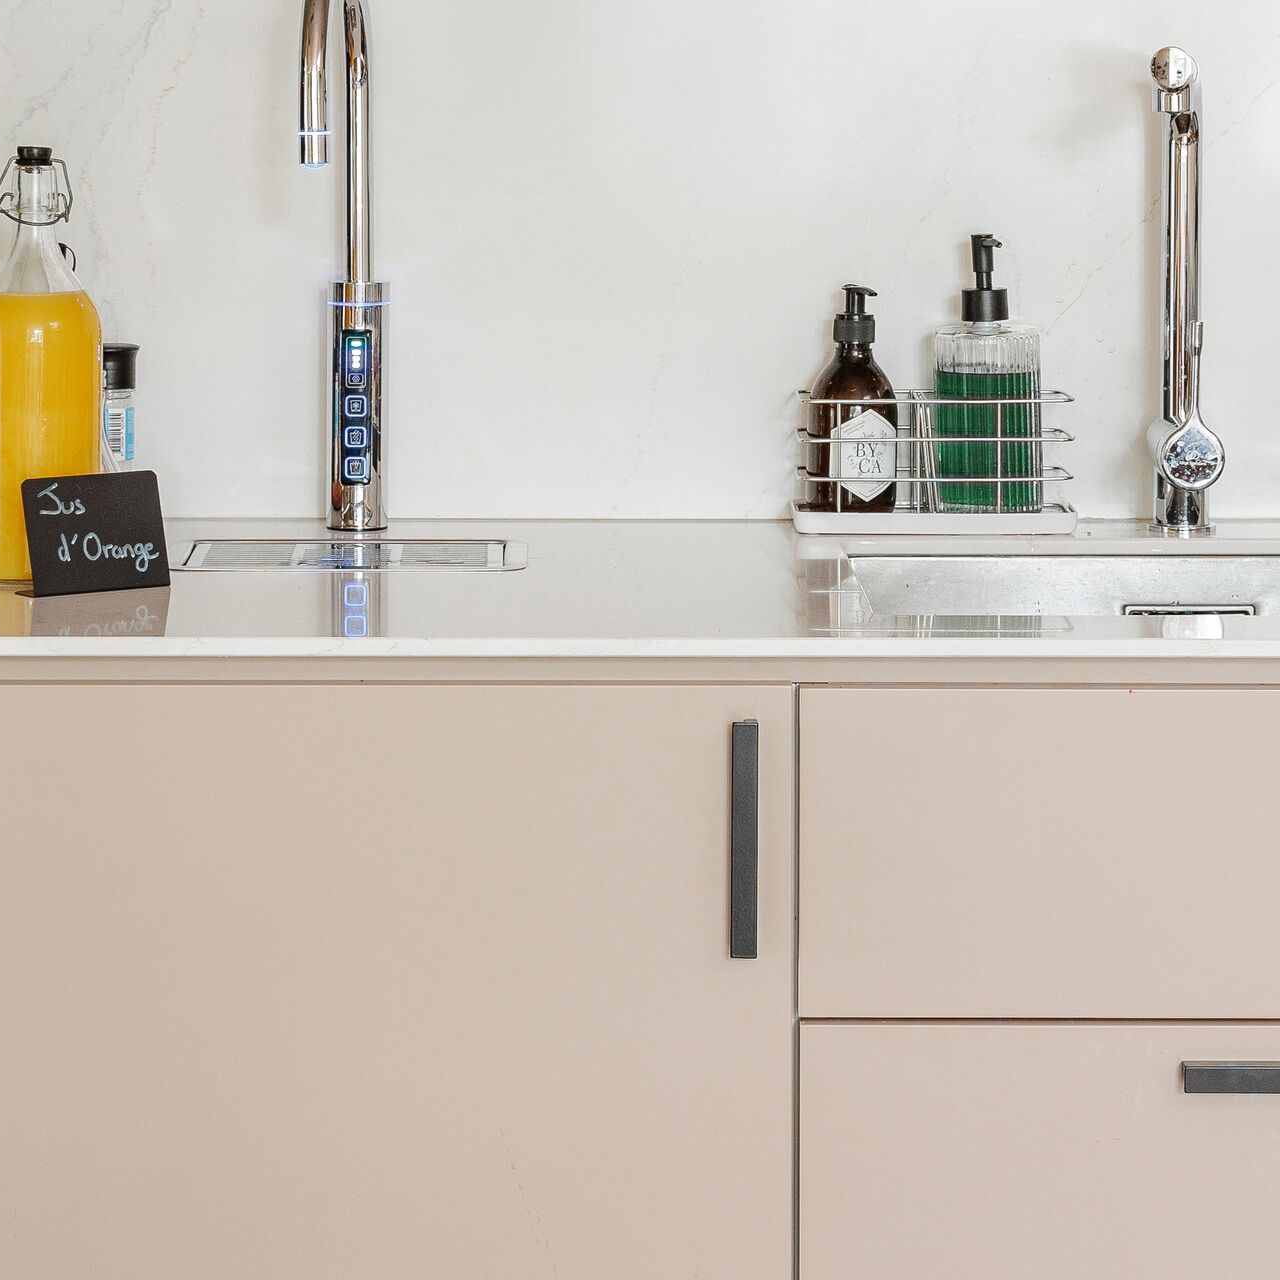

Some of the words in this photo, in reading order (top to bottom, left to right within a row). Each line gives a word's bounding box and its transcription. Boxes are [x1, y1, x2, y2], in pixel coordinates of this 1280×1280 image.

[856, 443, 880, 458] BY
[859, 458, 882, 474] CA
[37, 482, 86, 515] Jus
[57, 532, 160, 573] d'Orange
